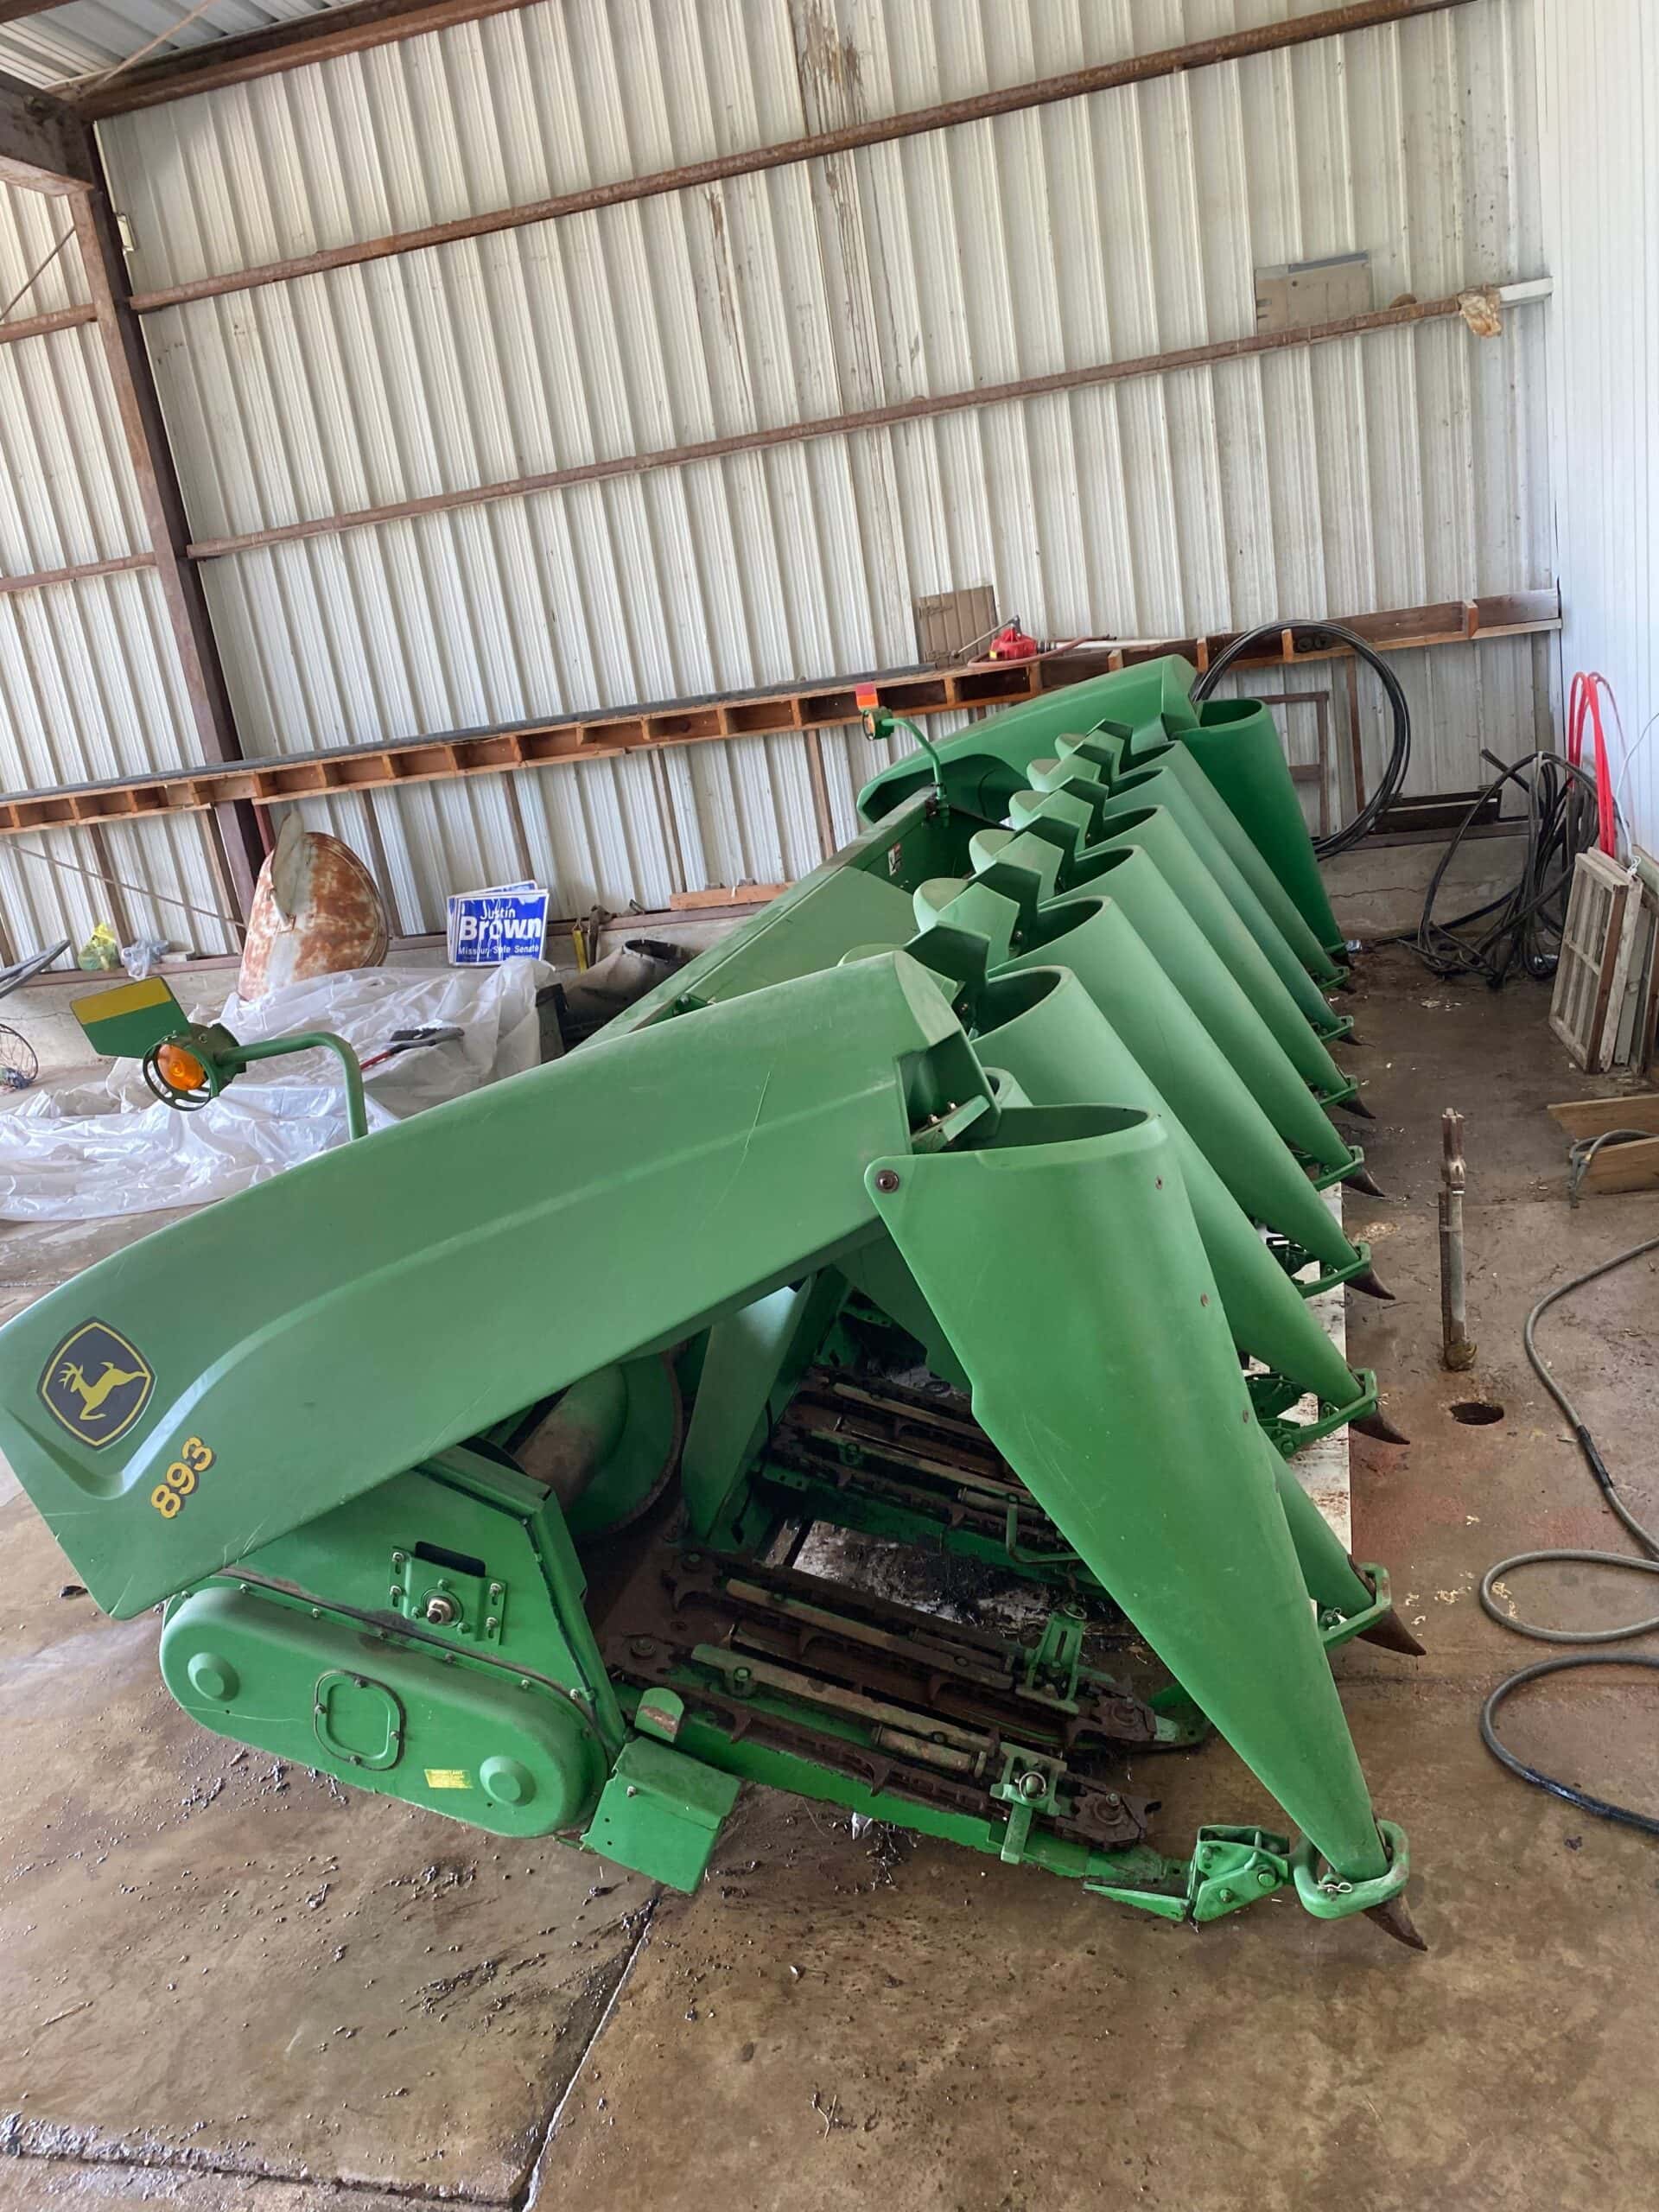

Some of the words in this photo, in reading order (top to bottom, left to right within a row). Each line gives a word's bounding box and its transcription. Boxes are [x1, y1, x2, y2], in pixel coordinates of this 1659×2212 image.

[480, 903, 516, 920] Justin
[460, 916, 542, 941] Brown
[493, 945, 511, 955] Sate
[150, 1436, 214, 1519] 893
